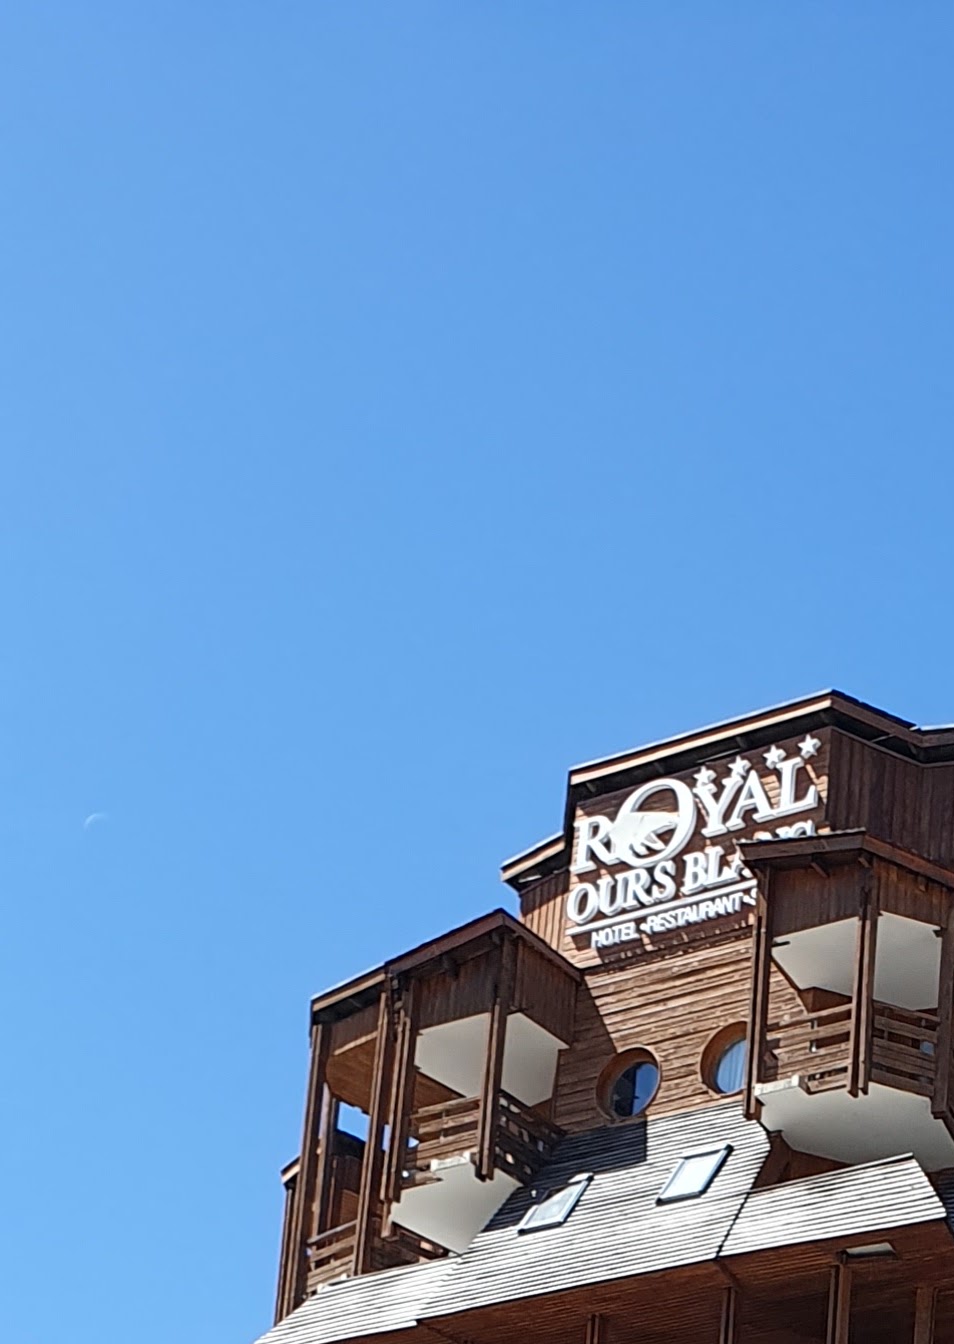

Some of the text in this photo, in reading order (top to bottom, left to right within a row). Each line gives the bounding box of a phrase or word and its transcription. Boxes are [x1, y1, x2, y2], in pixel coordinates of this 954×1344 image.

[569, 757, 818, 876] ROYAL
[566, 860, 678, 925] OURS
[591, 920, 641, 949] HOTEL
[645, 892, 745, 935] RESTAURANT
